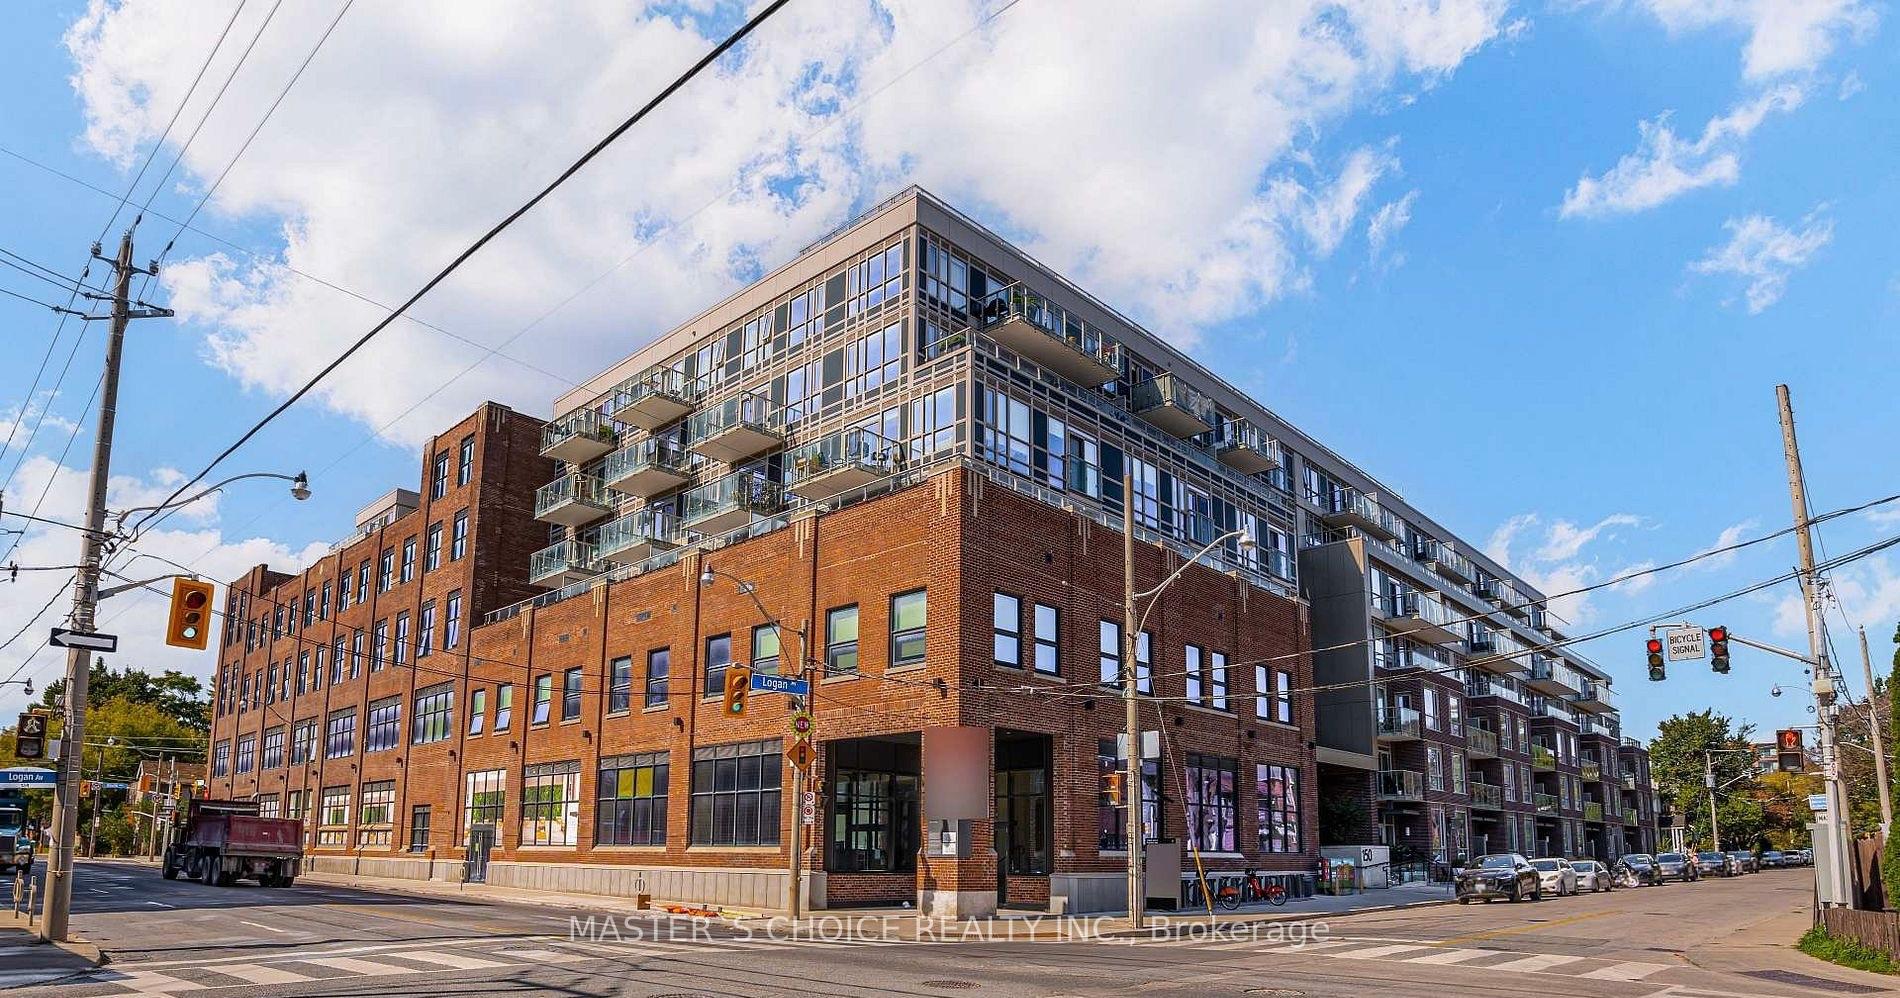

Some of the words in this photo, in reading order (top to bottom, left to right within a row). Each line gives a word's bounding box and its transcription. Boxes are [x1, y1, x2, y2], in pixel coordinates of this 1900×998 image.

[1669, 633, 1701, 644] BICYCLE
[1672, 644, 1700, 654] SIGNAL
[762, 677, 788, 690] Logan
[8, 772, 34, 782] Logan
